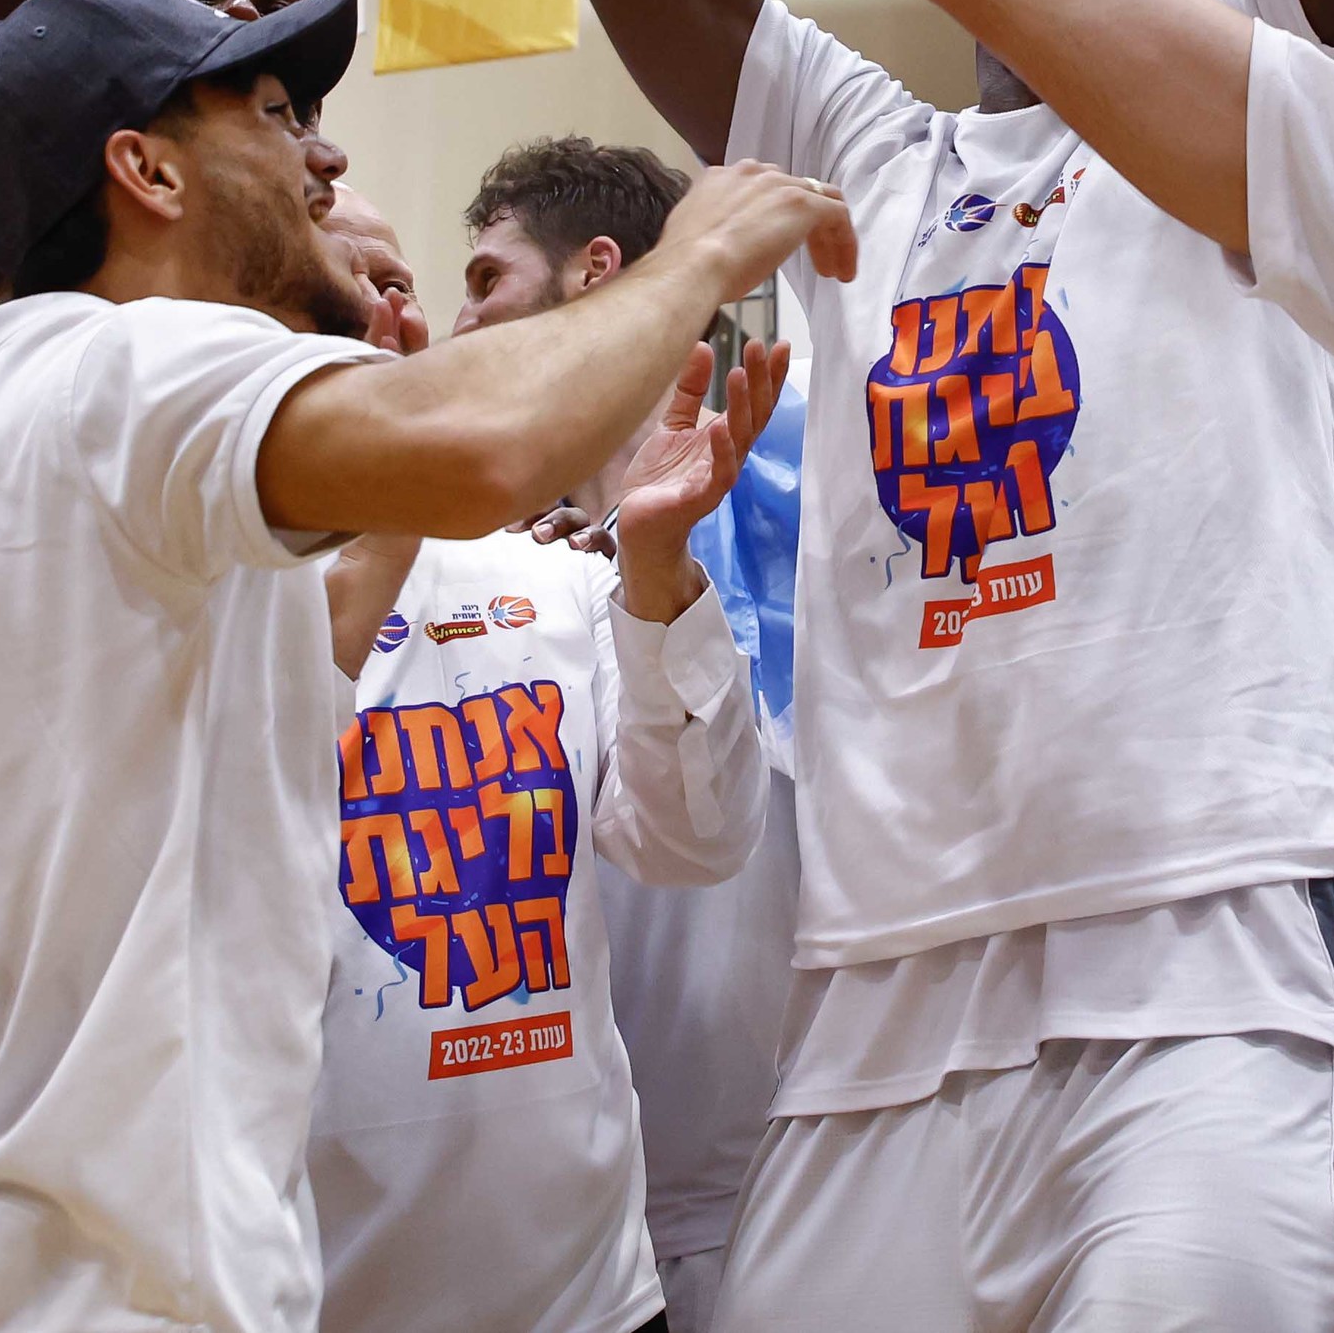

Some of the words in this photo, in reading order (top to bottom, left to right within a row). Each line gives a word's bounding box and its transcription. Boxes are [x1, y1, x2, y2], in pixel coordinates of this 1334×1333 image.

[989, 570, 1043, 602] עונת
[434, 625, 482, 640] Winner
[339, 684, 566, 801] אנחנו
[341, 784, 570, 904] בליגת
[390, 897, 571, 1010] העל
[440, 1030, 526, 1066] 2022-23
[529, 1022, 566, 1052] עונת
